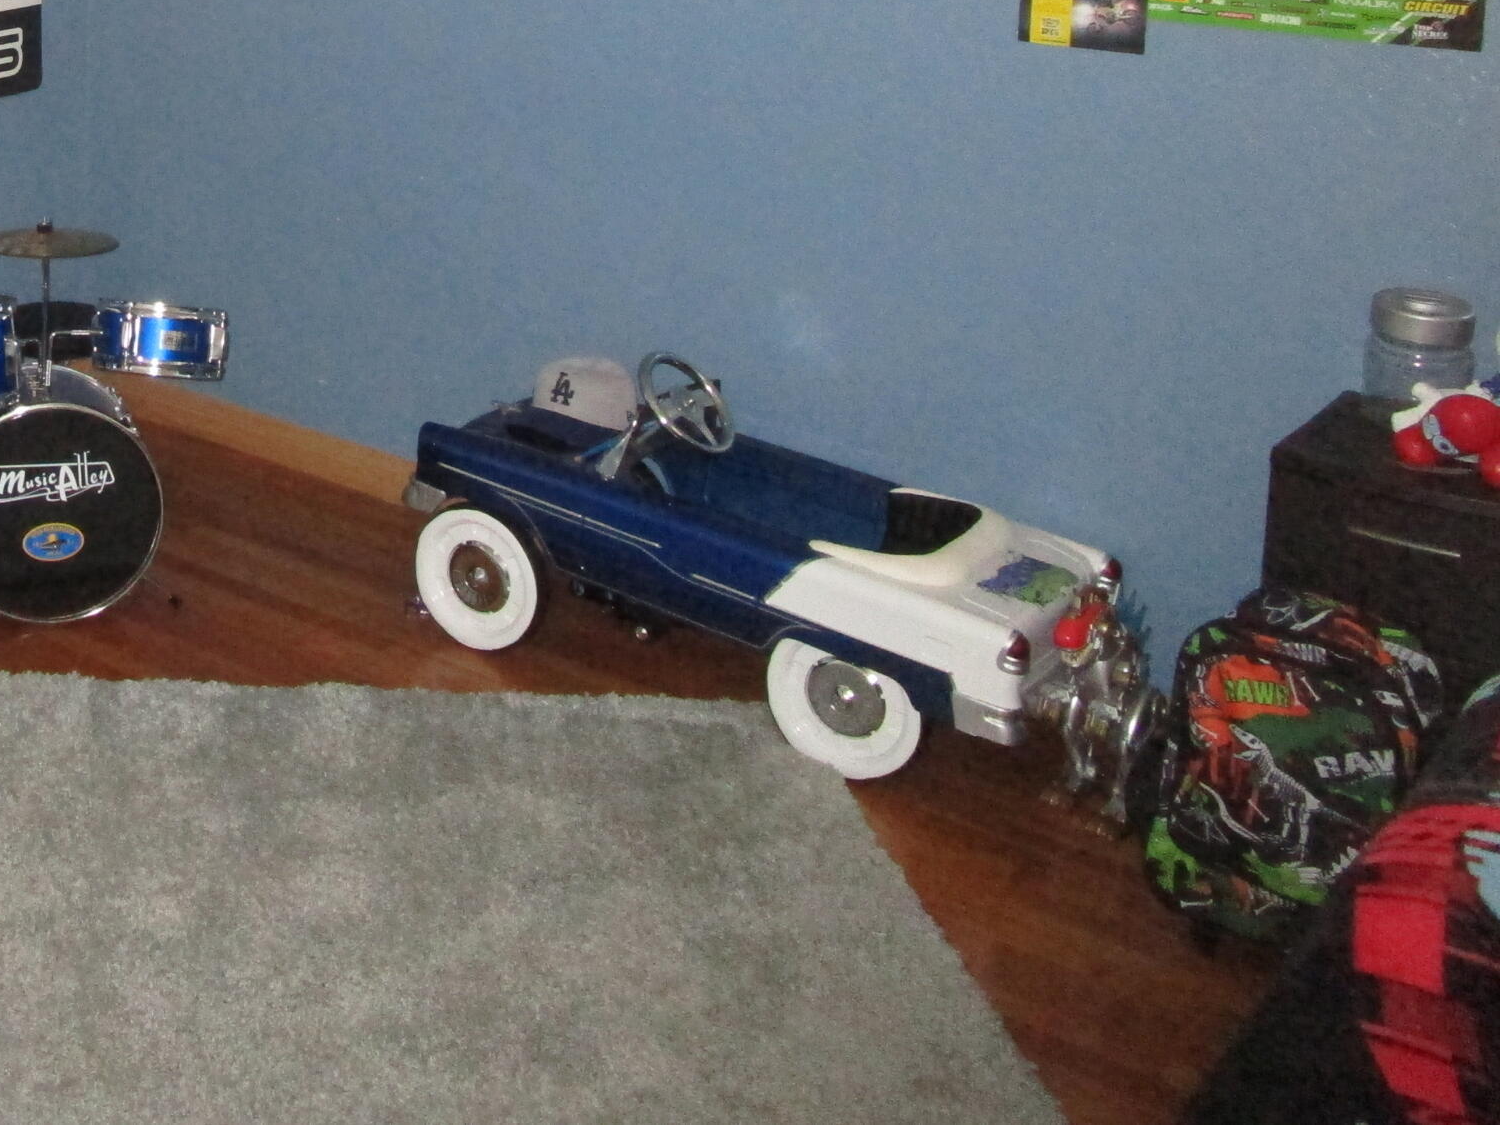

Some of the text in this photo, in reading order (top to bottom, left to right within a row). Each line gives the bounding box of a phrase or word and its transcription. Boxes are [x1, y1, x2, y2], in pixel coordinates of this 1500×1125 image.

[1404, 0, 1470, 15] CIRCUIT
[550, 371, 575, 406] LA
[55, 450, 108, 502] Alley
